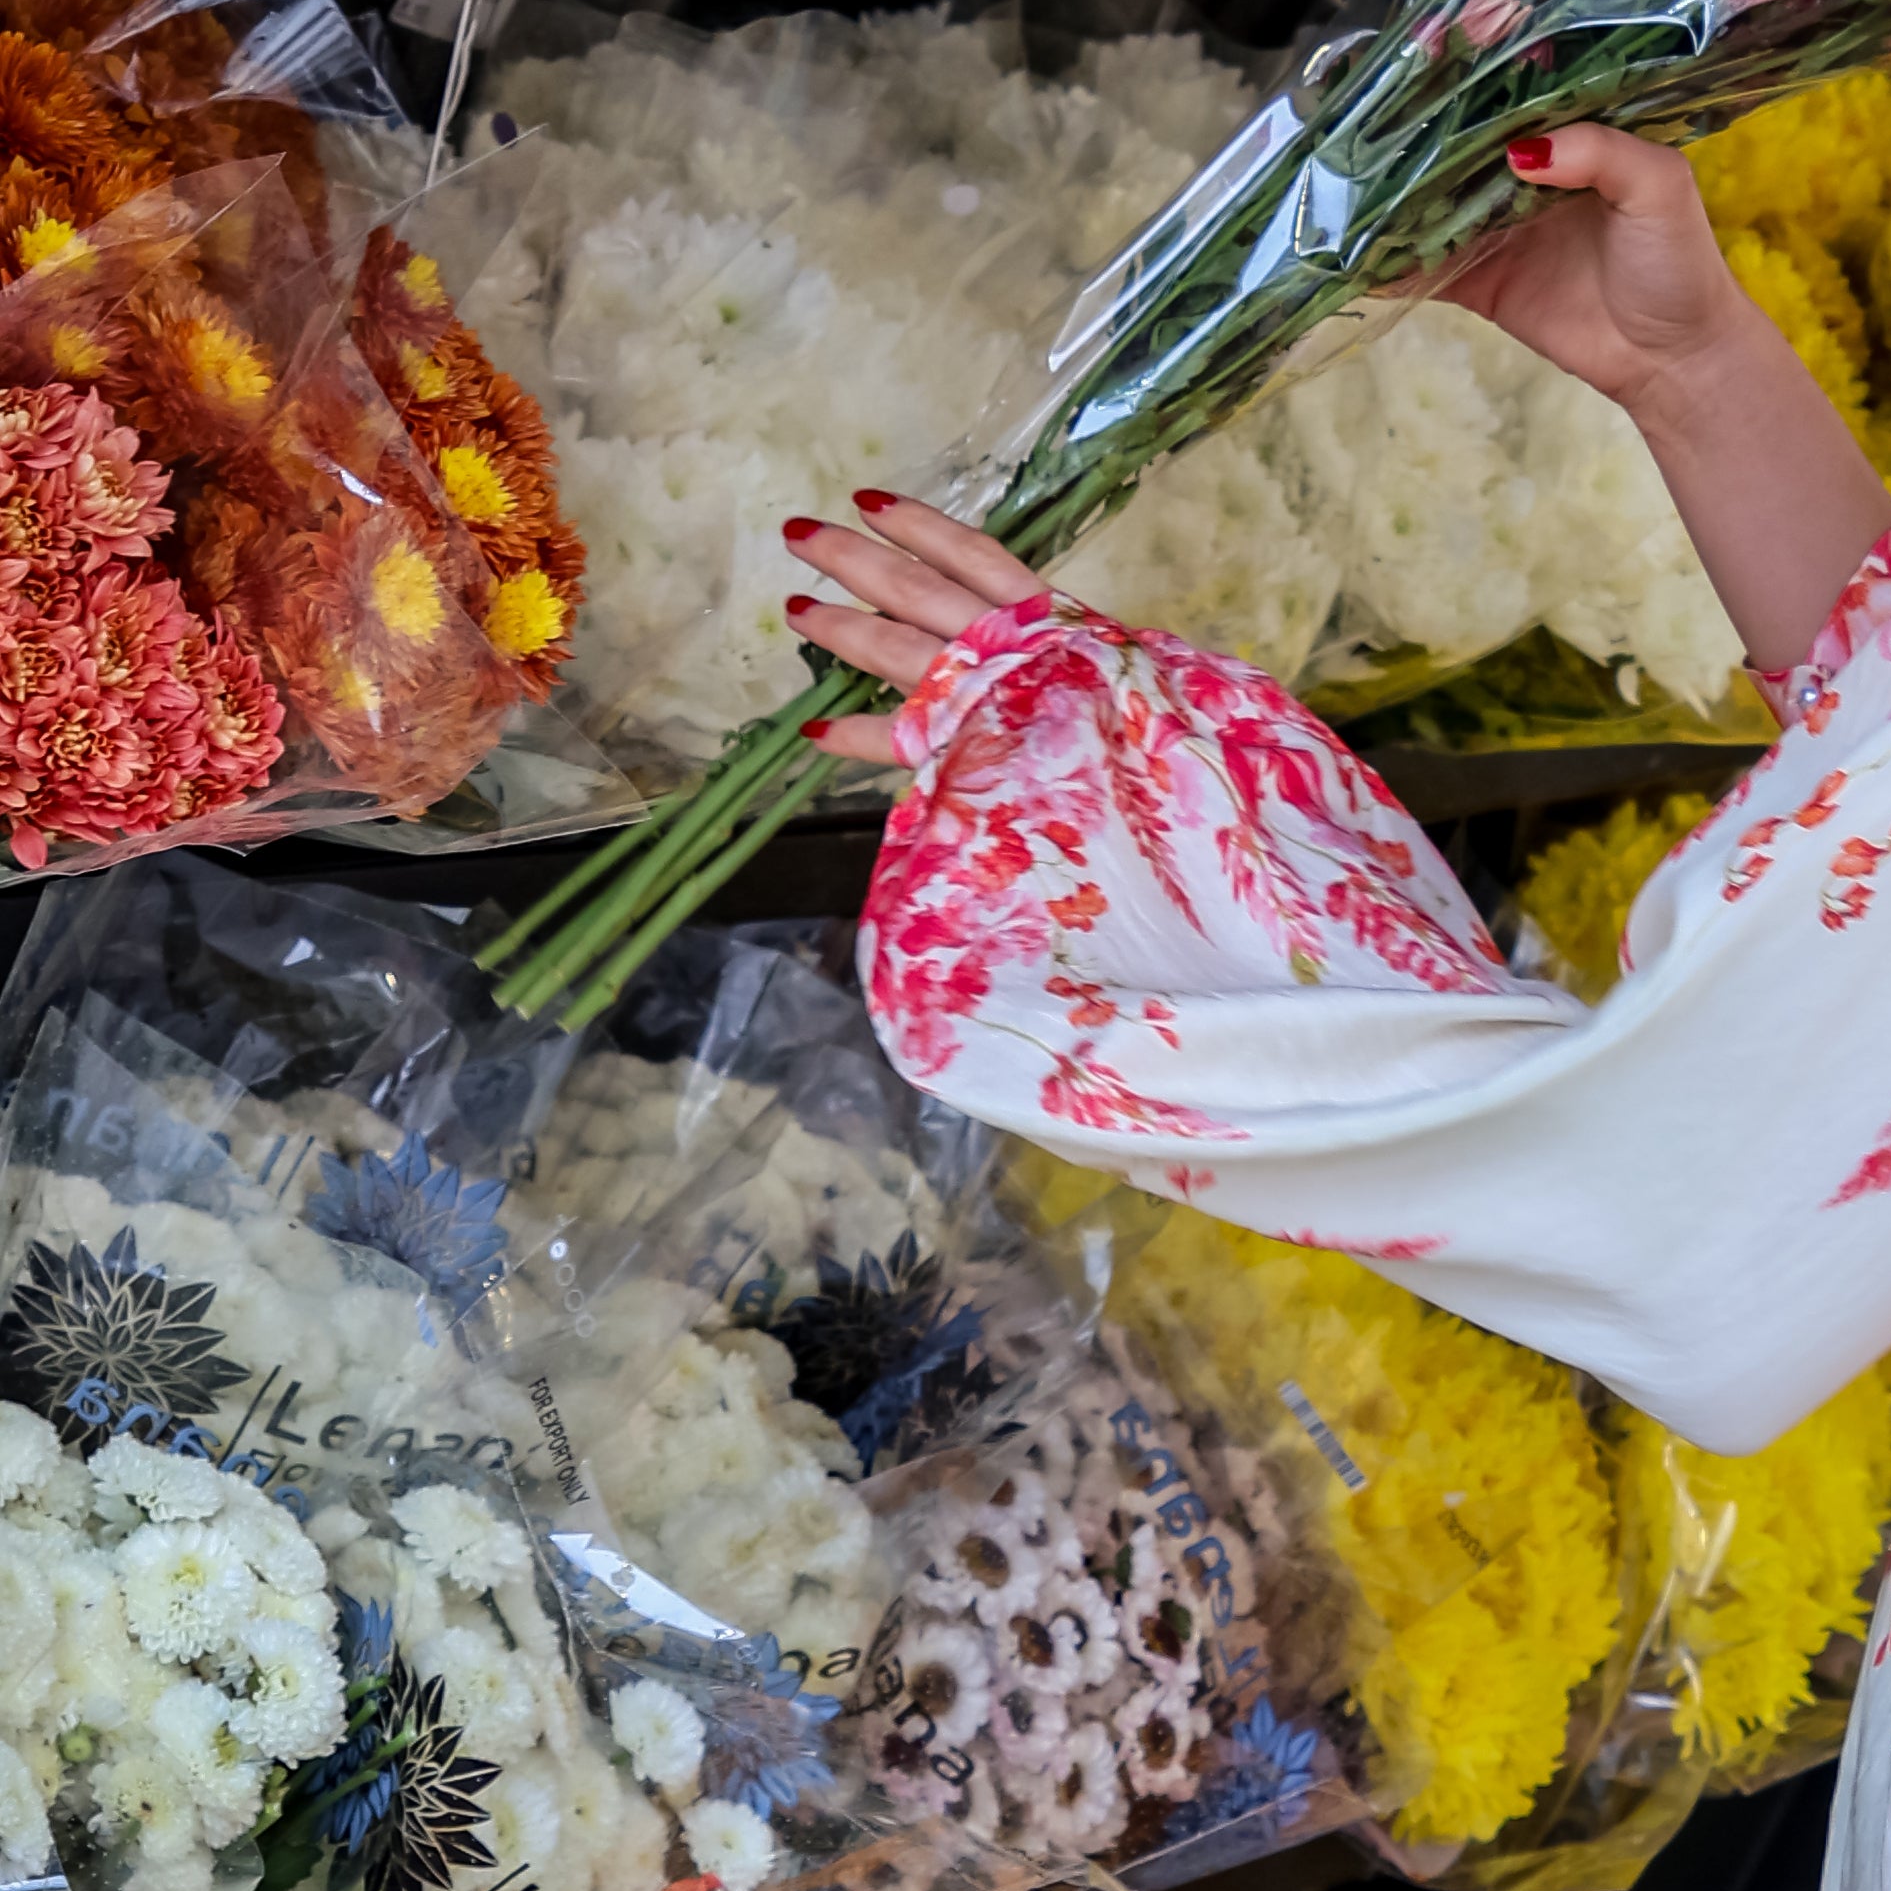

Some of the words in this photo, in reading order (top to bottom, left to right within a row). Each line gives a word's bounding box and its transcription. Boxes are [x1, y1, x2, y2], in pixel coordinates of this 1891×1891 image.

[528, 1376, 554, 1413] FOR
[539, 1409, 575, 1465] EXPORT
[556, 1461, 592, 1507] ONLY
